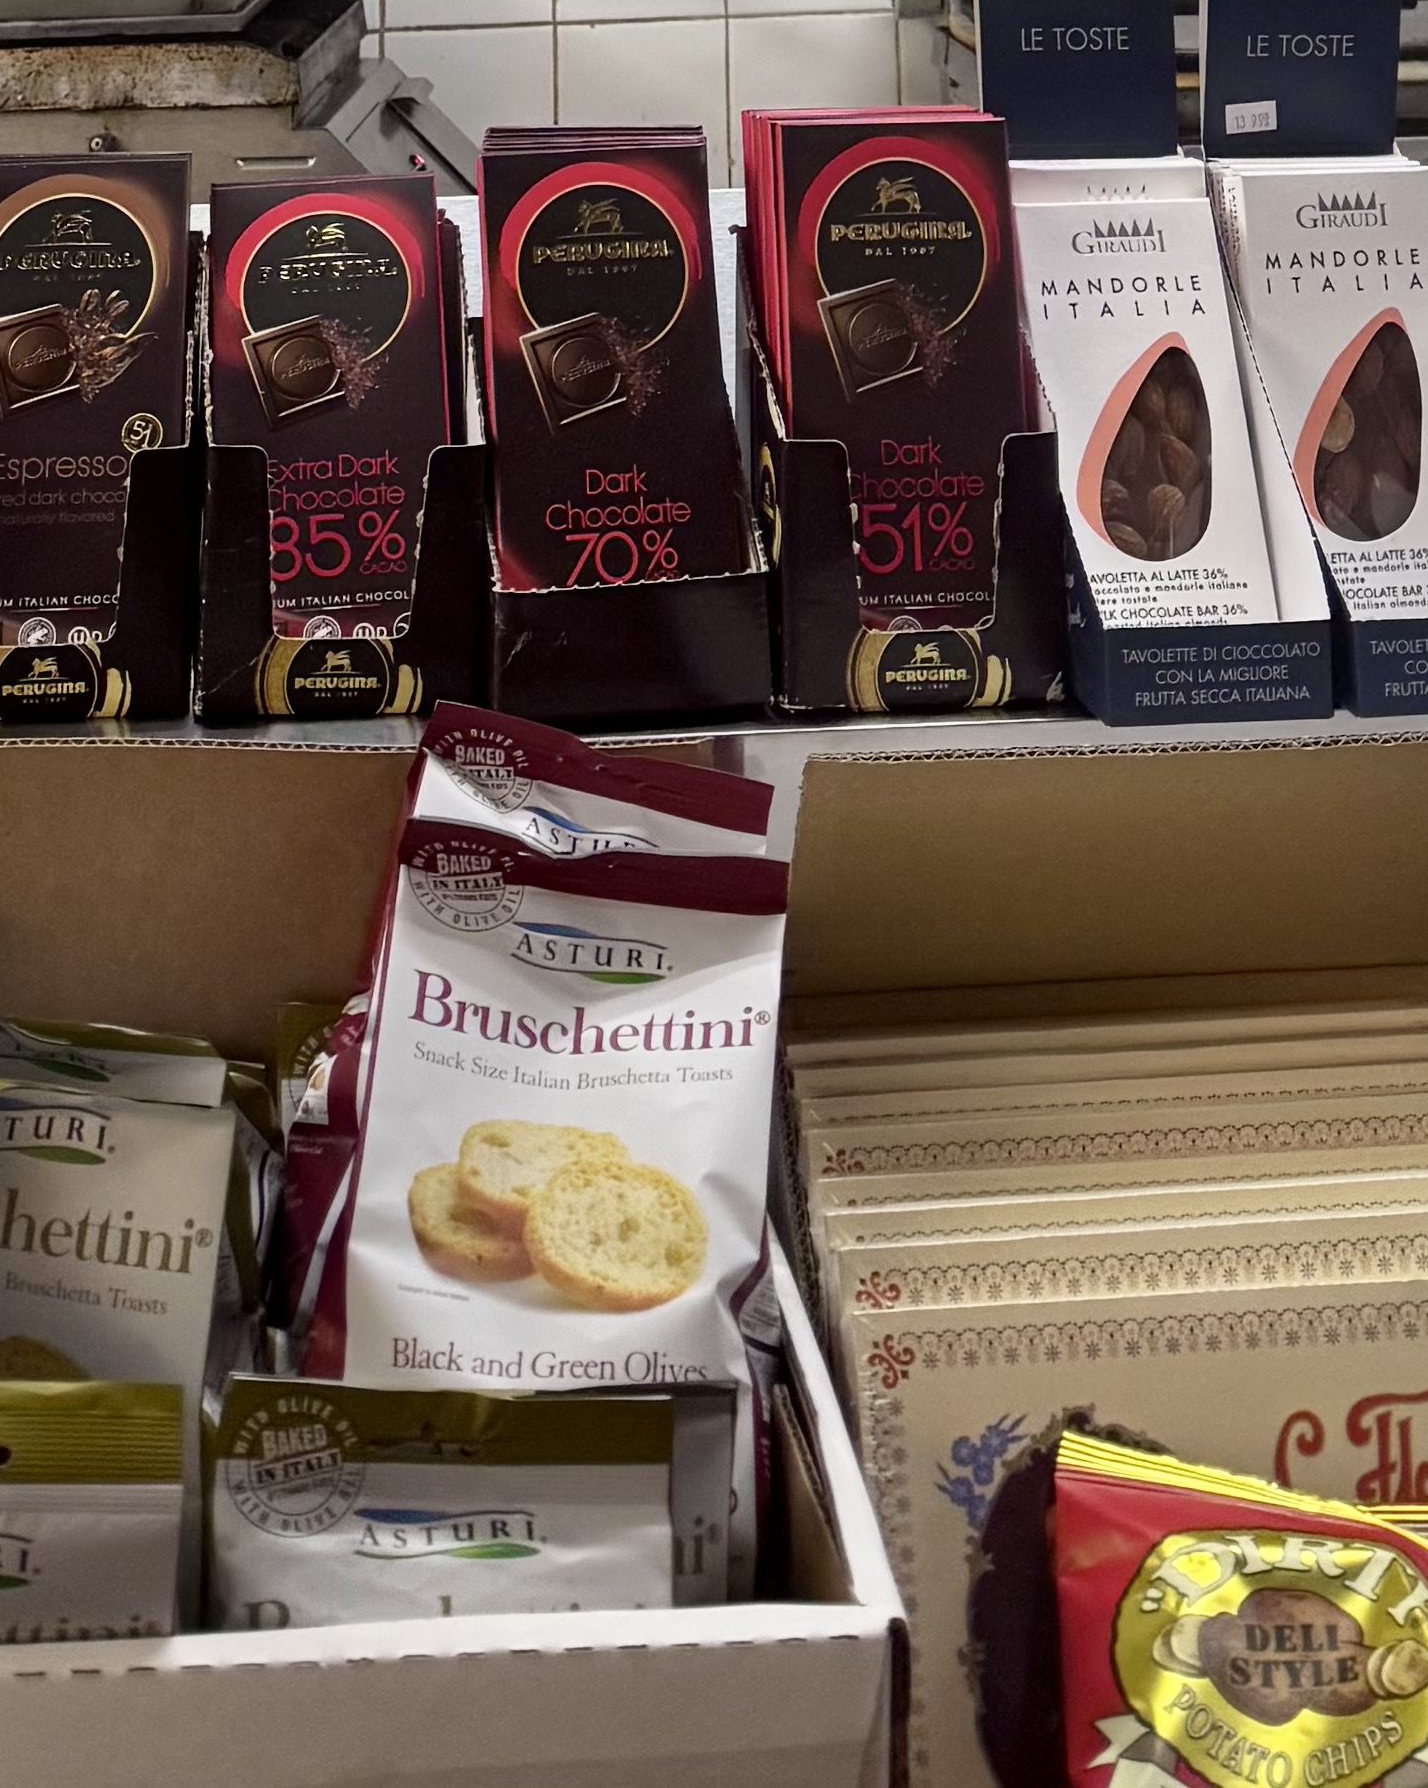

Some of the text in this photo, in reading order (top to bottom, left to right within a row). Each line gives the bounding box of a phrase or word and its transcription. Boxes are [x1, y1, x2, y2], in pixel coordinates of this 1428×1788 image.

[1022, 27, 1130, 51] LE TOSTE
[829, 221, 973, 243] PERUGINA
[1071, 229, 1166, 258] GIRAUDI
[532, 240, 674, 265] PERUGINA
[1041, 275, 1202, 298] MANDORLE
[1042, 298, 1207, 321] ITALIA
[880, 436, 943, 466] Dark
[337, 453, 400, 479] Dark
[585, 467, 647, 494] Dark
[849, 472, 985, 502] Chocolate
[544, 499, 692, 532] Chocolate
[858, 500, 973, 574] 51%
[566, 527, 679, 587] 70%
[1122, 640, 1320, 664] TAVOLETTE DI CIOCCOLATO
[884, 667, 970, 684] PERUGINA
[1155, 664, 1289, 686] CON LA MIGLIORE
[1135, 684, 1310, 707] FRUTTA SECCA ITALIANA
[455, 745, 505, 765] BAKED
[516, 933, 663, 971] ASTURI
[414, 1042, 733, 1090] Snack Size Italian Bruschetta Toasts
[391, 1336, 465, 1373] Black
[470, 1346, 524, 1379] and
[530, 1351, 617, 1383] Green
[1244, 1622, 1341, 1653] DELI
[1230, 1655, 1361, 1688] STYLE
[1164, 1685, 1405, 1788] POTATO CHIPS
